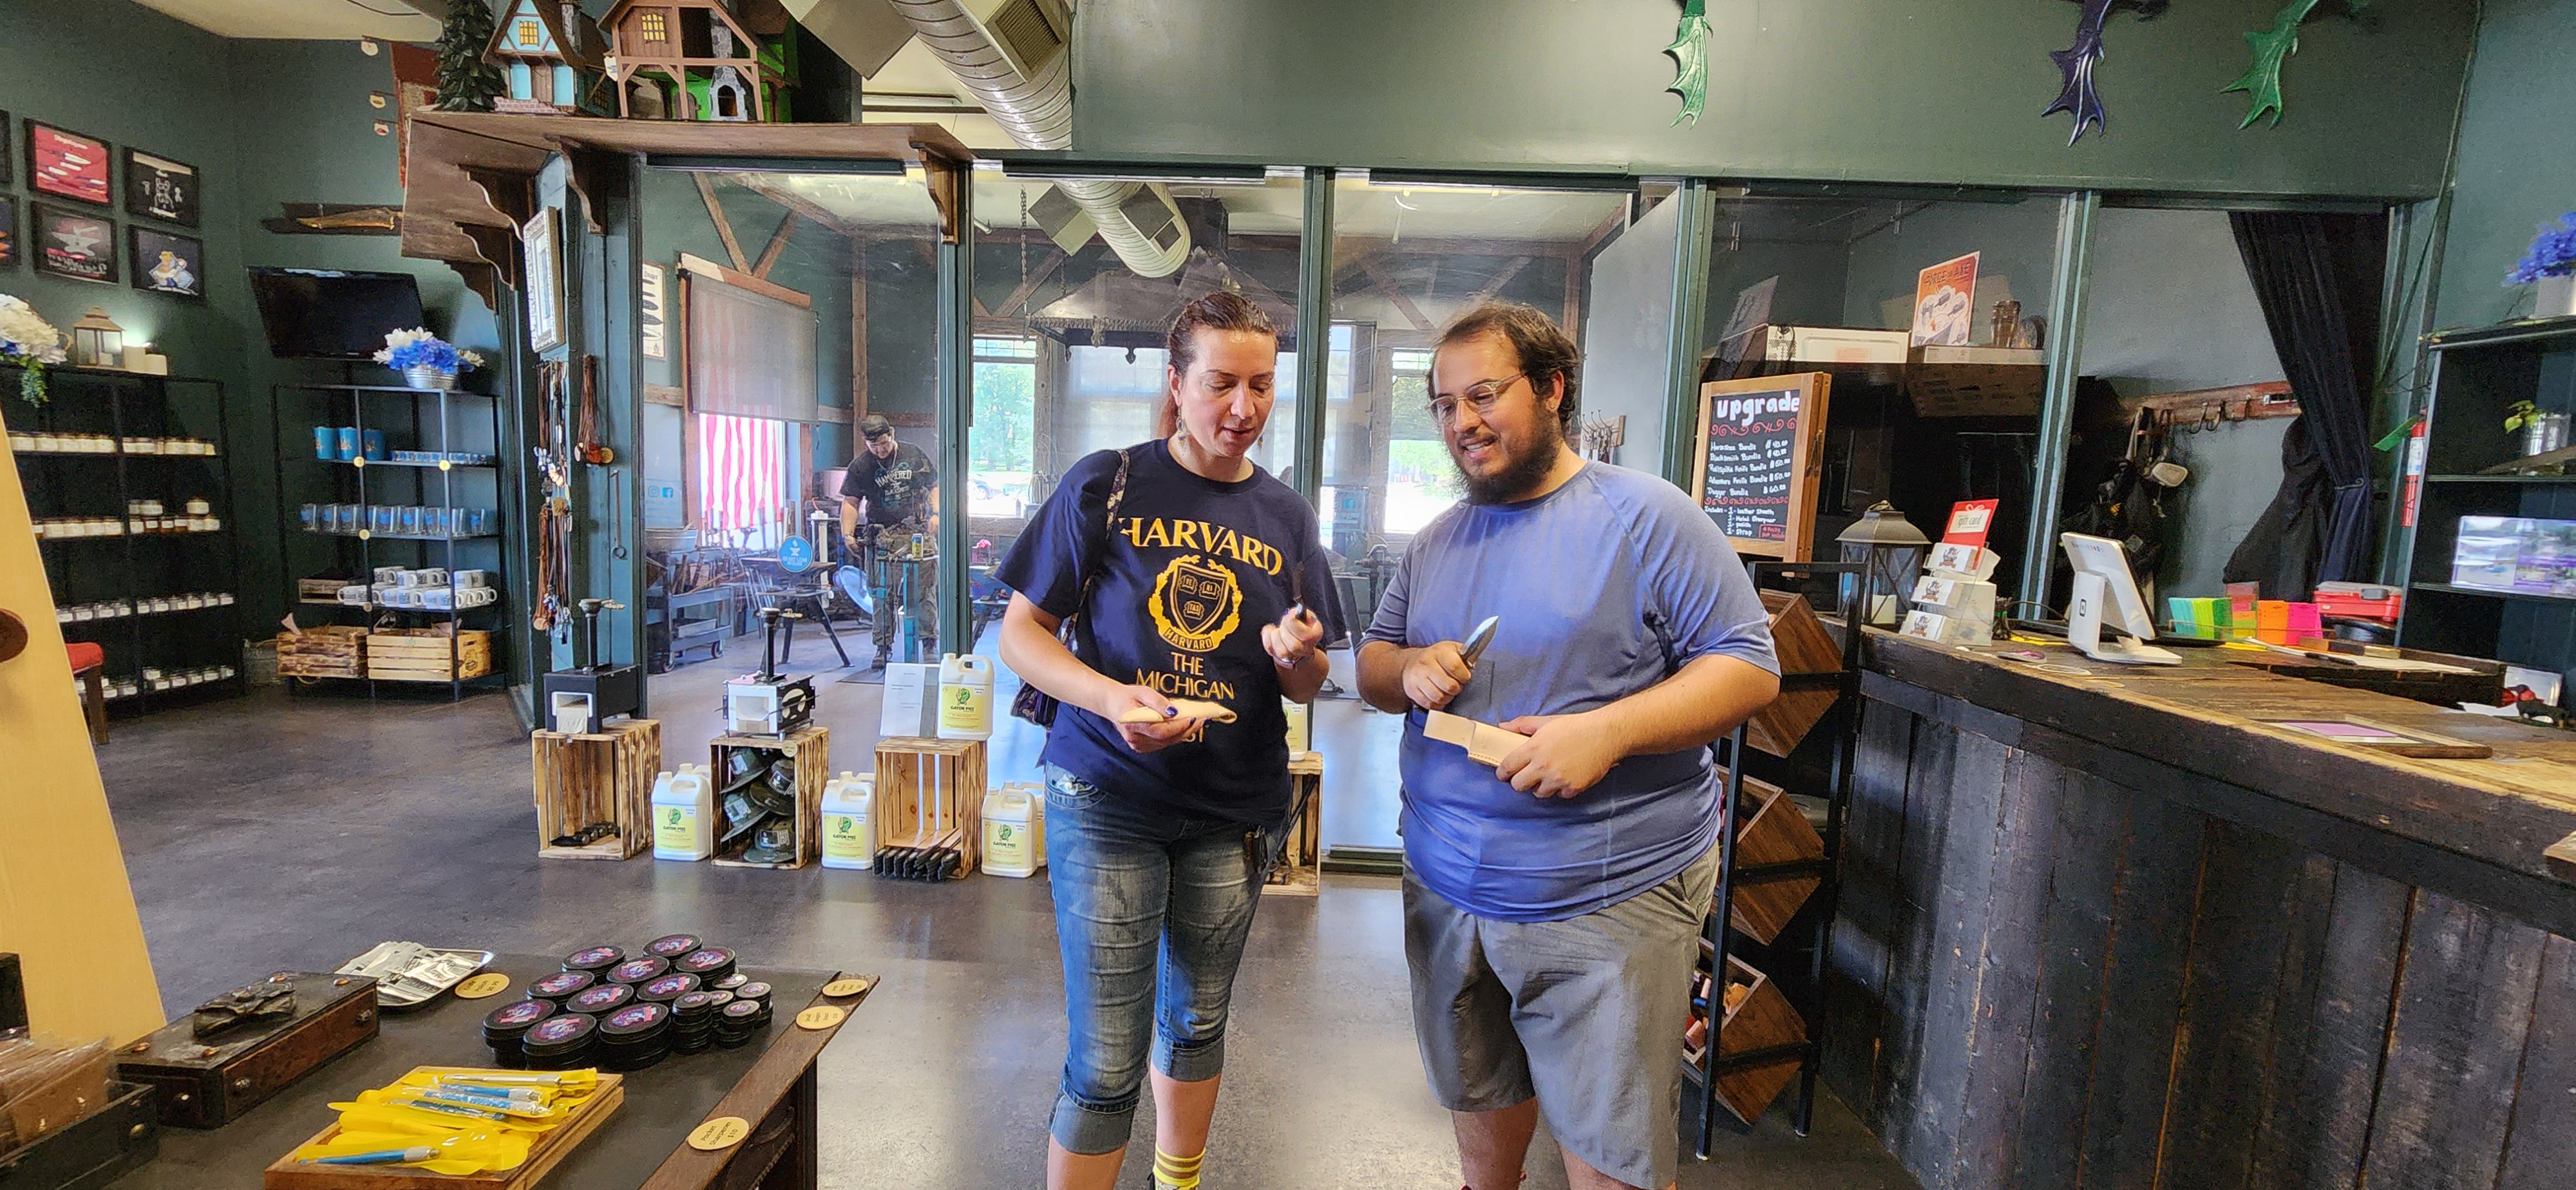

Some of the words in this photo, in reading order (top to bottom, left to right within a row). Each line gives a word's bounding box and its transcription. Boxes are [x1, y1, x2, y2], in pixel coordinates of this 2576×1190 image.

[1118, 517, 1282, 575] HARVARD
[1164, 628, 1212, 650] HARVARD
[1171, 652, 1204, 676] THE
[1136, 668, 1235, 700] MICHIGAN
[701, 1125, 717, 1141] Pocket
[727, 1129, 738, 1138] $10
